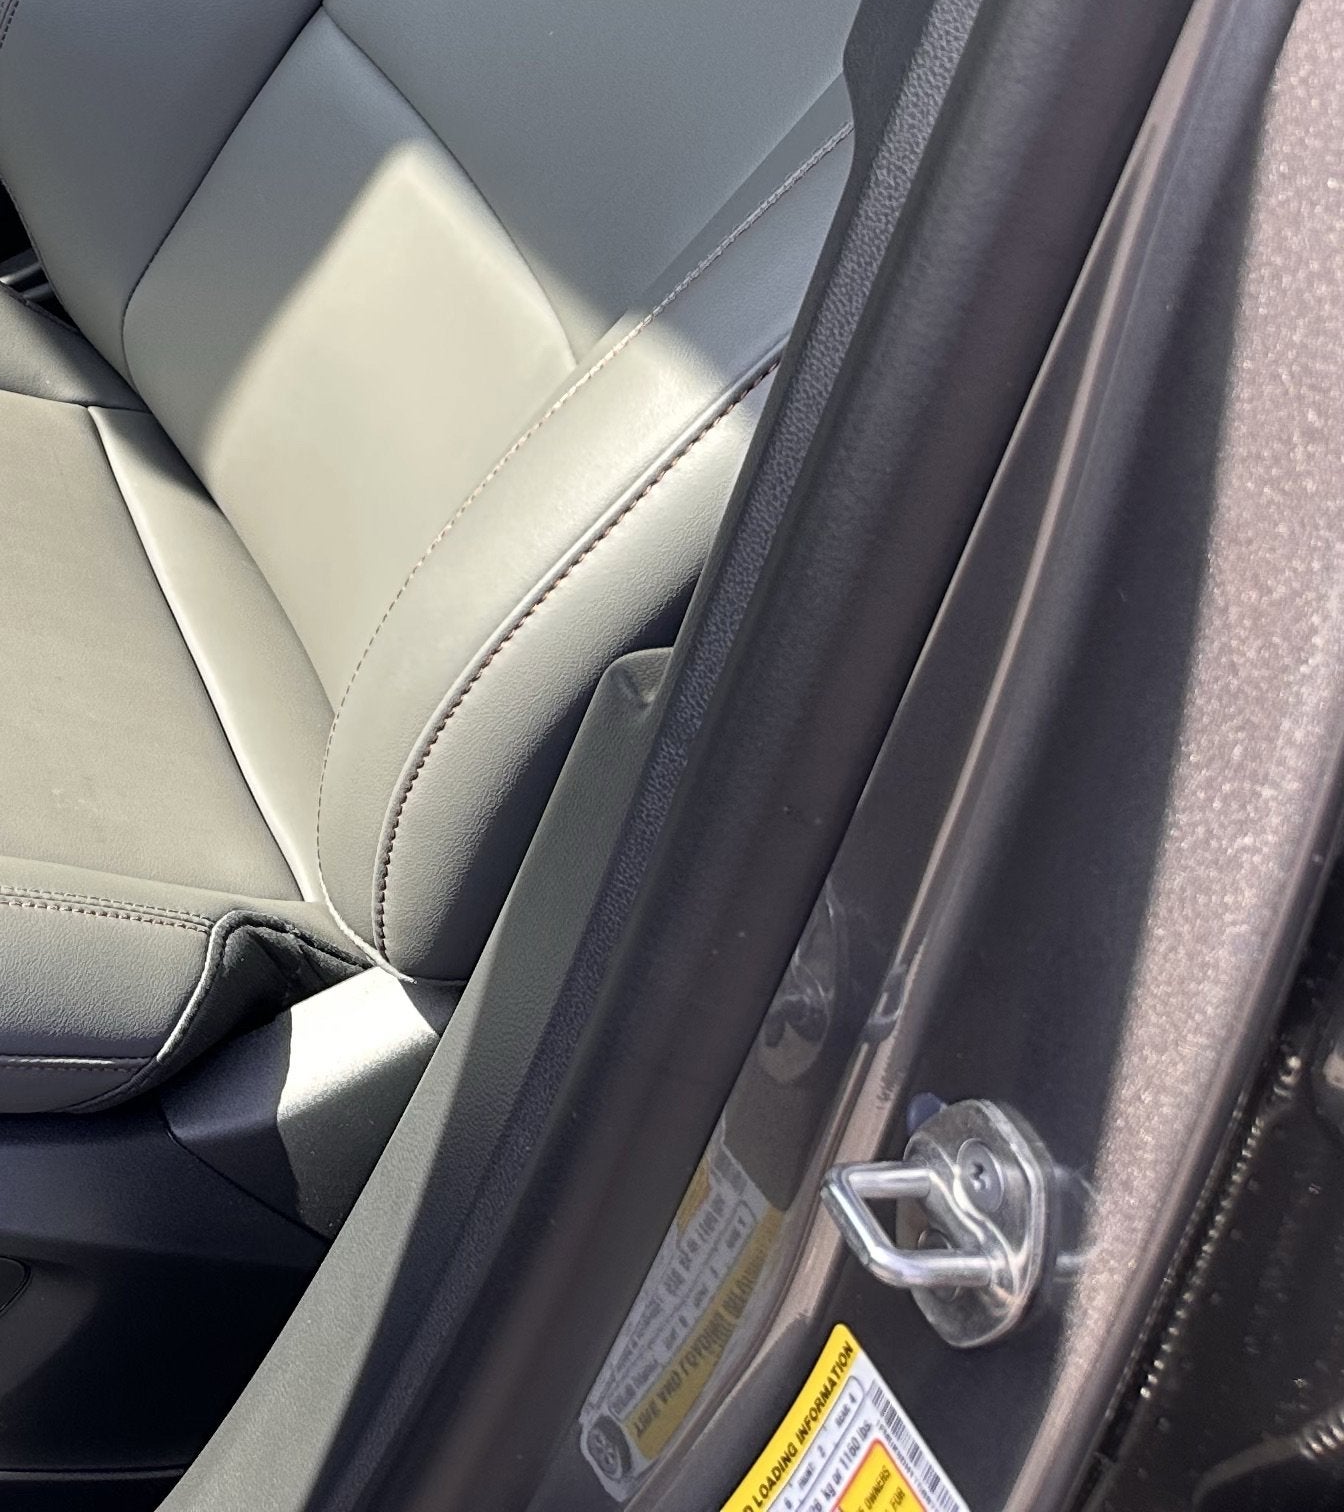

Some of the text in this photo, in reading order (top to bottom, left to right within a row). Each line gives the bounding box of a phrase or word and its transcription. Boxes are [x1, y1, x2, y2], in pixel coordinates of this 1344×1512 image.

[751, 1340, 854, 1505] LOADING INFORMATION
[823, 1482, 837, 1500] kg
[839, 1438, 861, 1471] 1160
